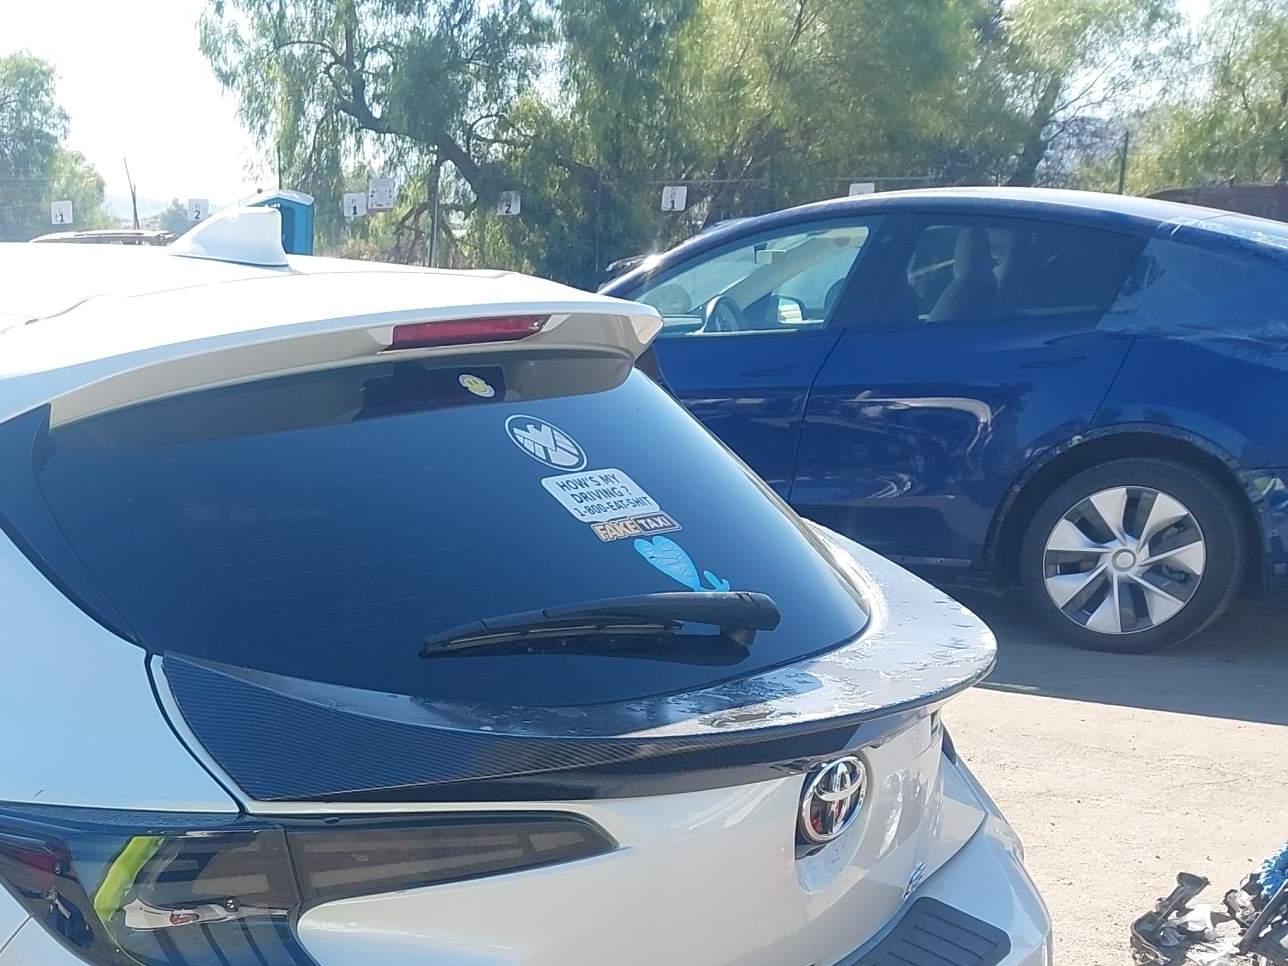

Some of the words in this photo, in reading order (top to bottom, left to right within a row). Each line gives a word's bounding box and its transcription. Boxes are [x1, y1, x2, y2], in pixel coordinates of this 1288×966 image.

[556, 475, 601, 492] HOW'S
[598, 473, 622, 487] MY
[573, 495, 654, 517] 1-800-EAT-SHIT
[594, 519, 641, 541] FAKE
[637, 515, 673, 530] TAXI
